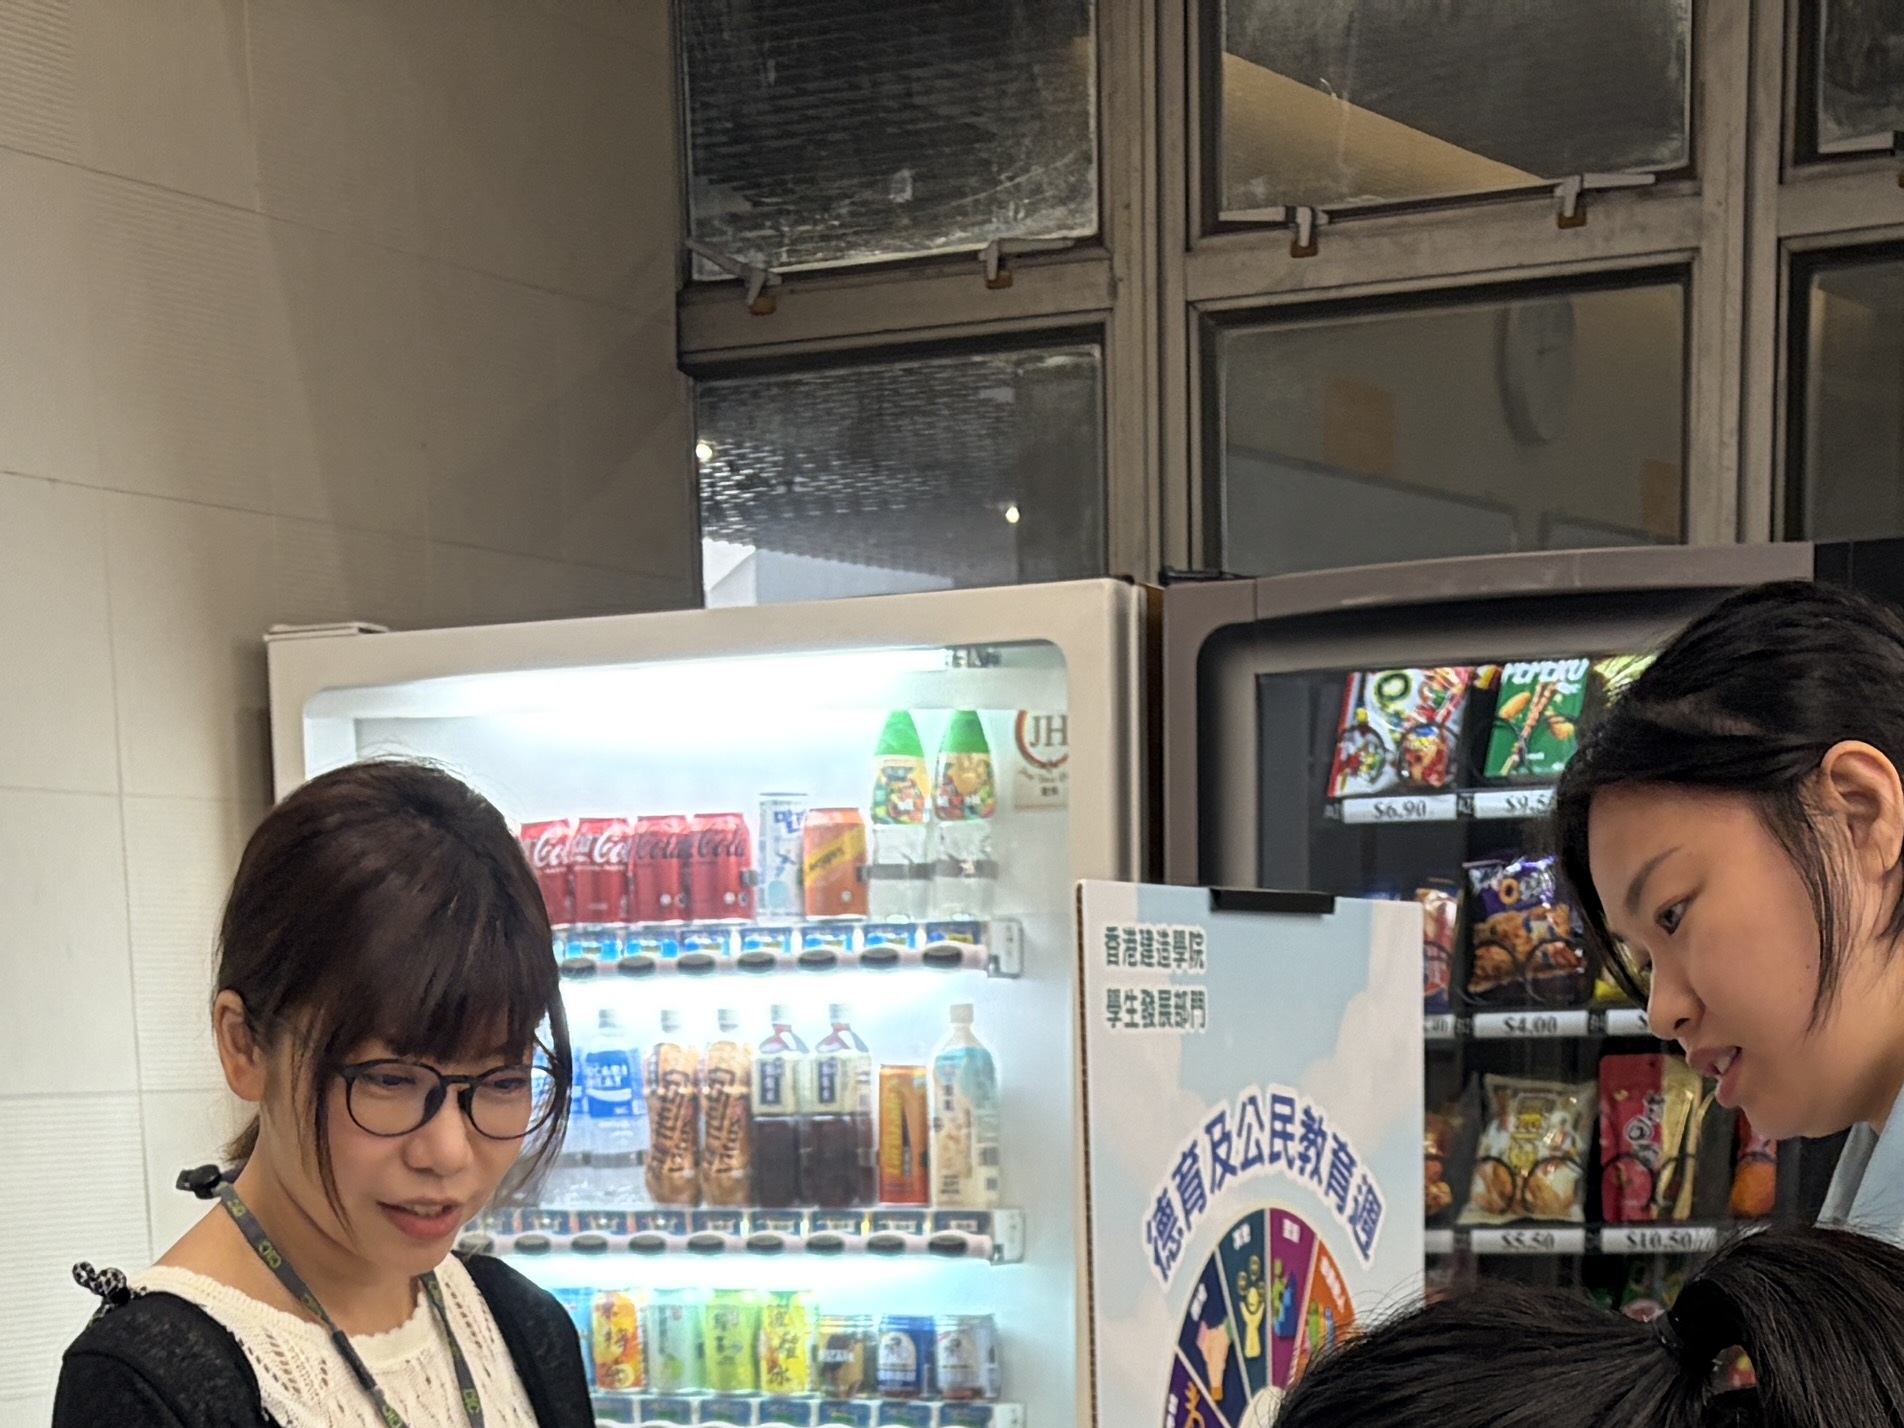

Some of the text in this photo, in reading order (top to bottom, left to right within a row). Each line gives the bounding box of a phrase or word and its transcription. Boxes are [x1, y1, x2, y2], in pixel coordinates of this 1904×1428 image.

[1104, 925, 1205, 970] 香港建造學院
[1105, 988, 1207, 1030] 學生發展部門
[1146, 1092, 1384, 1283] 德育及公民教育週
